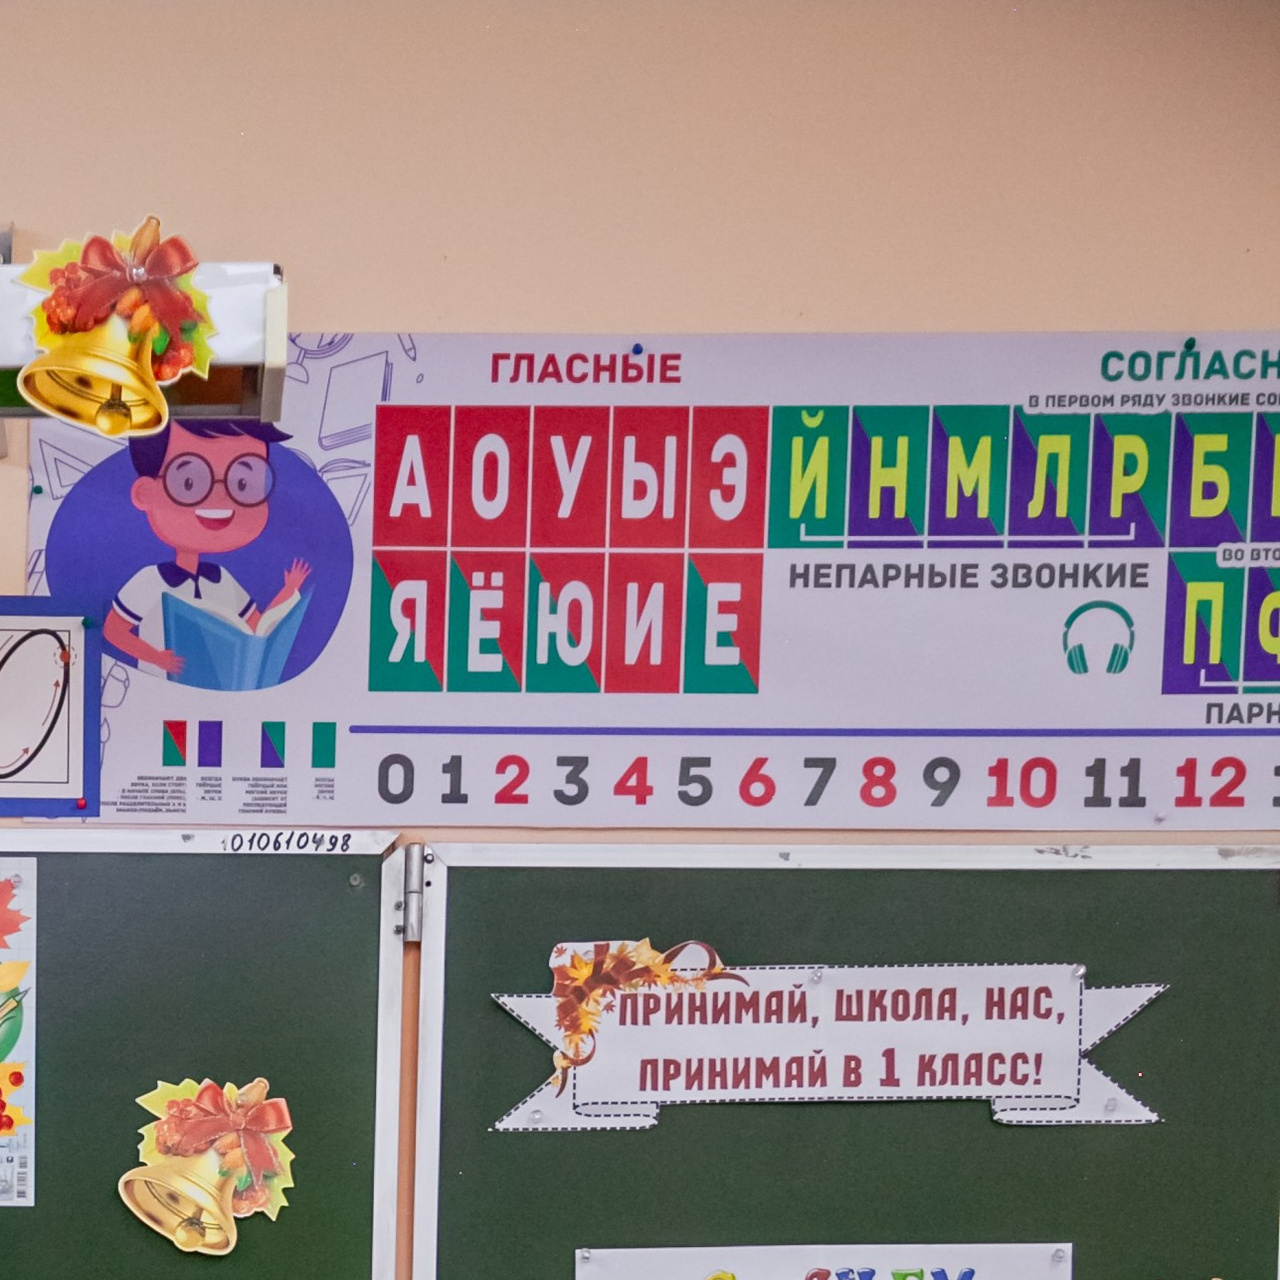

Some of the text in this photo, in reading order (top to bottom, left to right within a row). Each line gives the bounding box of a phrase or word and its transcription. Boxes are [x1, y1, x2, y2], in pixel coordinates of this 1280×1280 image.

[490, 352, 682, 384] ГЛАСНЫЕ
[1029, 392, 1280, 408] В ПЕРВОМ РЯДУ ЗВОНКИЕ СО
[1222, 548, 1244, 561] ВО
[789, 562, 1150, 590] НЕПАРНЫЕ ЗВОНКИЕ
[378, 753, 414, 804] 0
[441, 755, 468, 804] 1
[494, 754, 530, 804] 2
[553, 756, 589, 806] 3
[613, 756, 653, 805] 4
[677, 757, 713, 806] 5
[738, 757, 776, 806] 6
[803, 757, 837, 806] 7
[859, 756, 898, 807] 8
[923, 756, 961, 807] 9
[986, 757, 1058, 807] 10
[1083, 757, 1146, 807] 11
[1175, 756, 1247, 807] 12
[619, 984, 1065, 1028] ПРИНИМАЙ, ШКОЛА, НАС,
[639, 1048, 1043, 1091] ПРИНИМАЙ В 1 КЛАСС!
